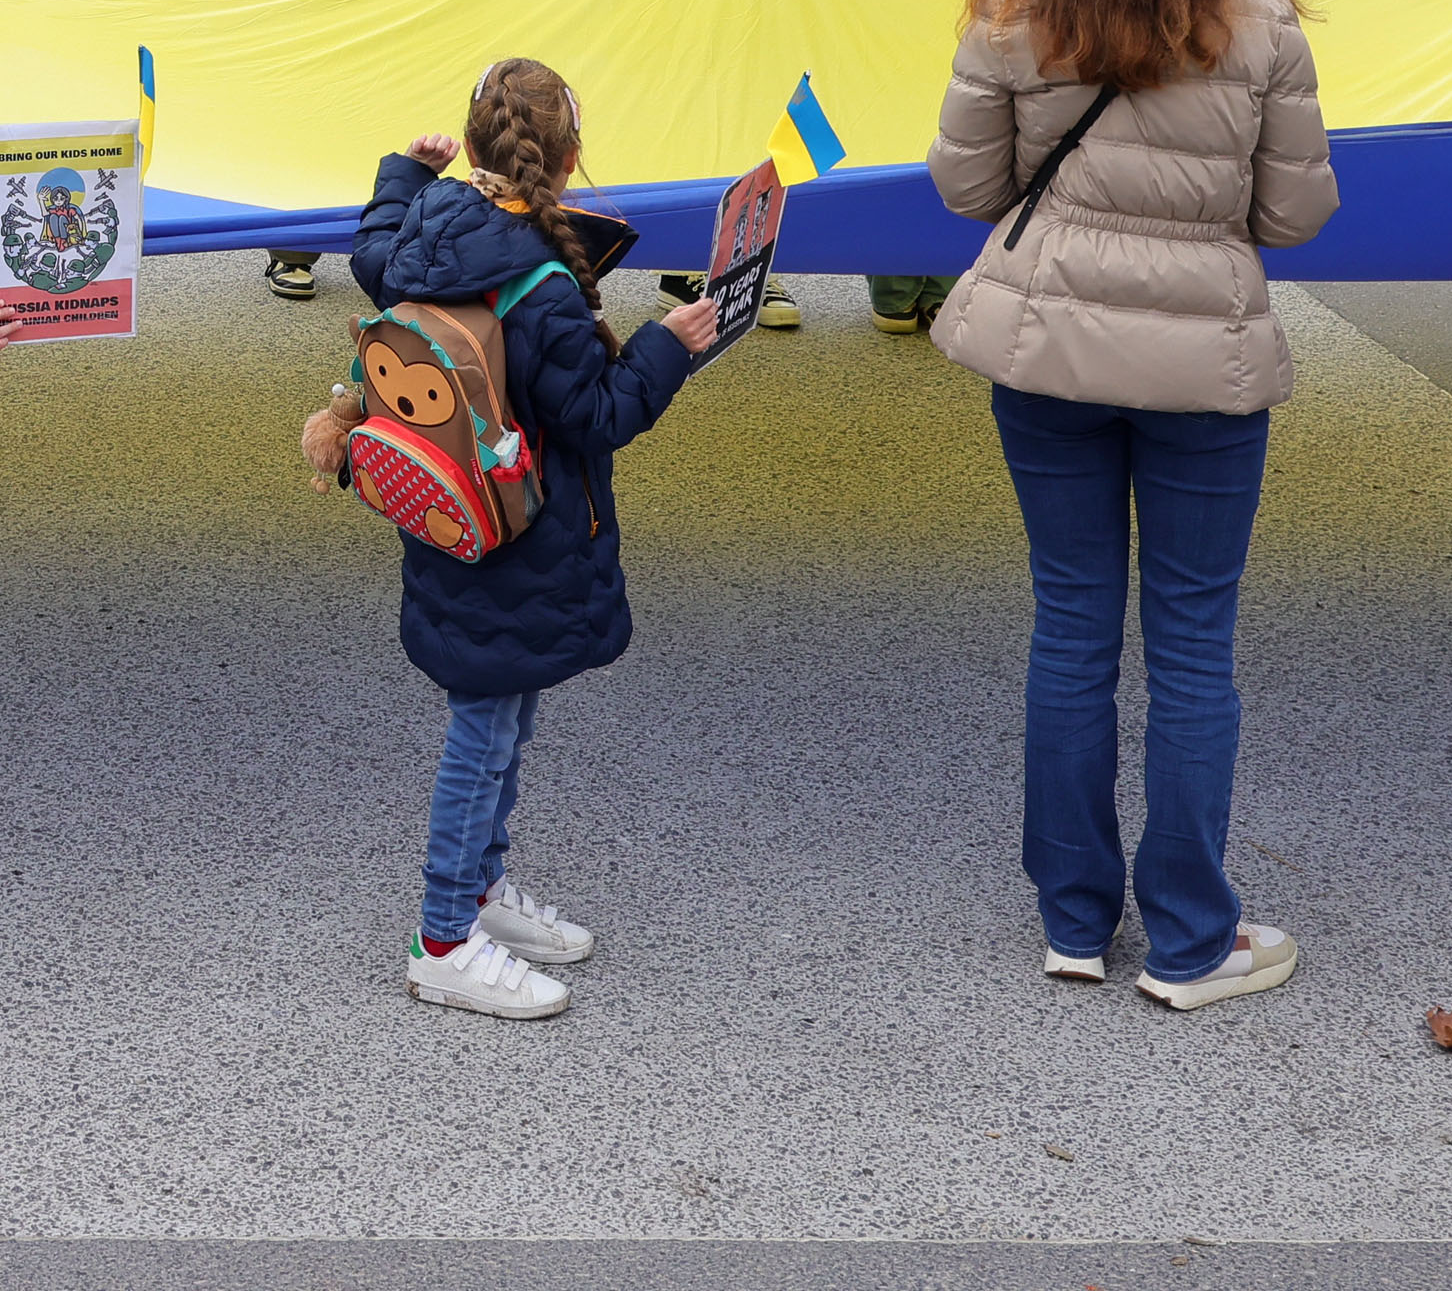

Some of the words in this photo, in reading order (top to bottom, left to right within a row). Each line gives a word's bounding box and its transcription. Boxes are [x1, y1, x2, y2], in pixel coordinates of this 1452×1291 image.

[35, 150, 58, 160] OUR
[60, 149, 88, 159] KIDS
[90, 147, 123, 157] HOME
[728, 261, 764, 299] YEARS
[3, 300, 51, 313] SSIA
[54, 296, 119, 311] KIDNAPS
[724, 285, 754, 325] WAR
[64, 310, 119, 323] CHILDREN
